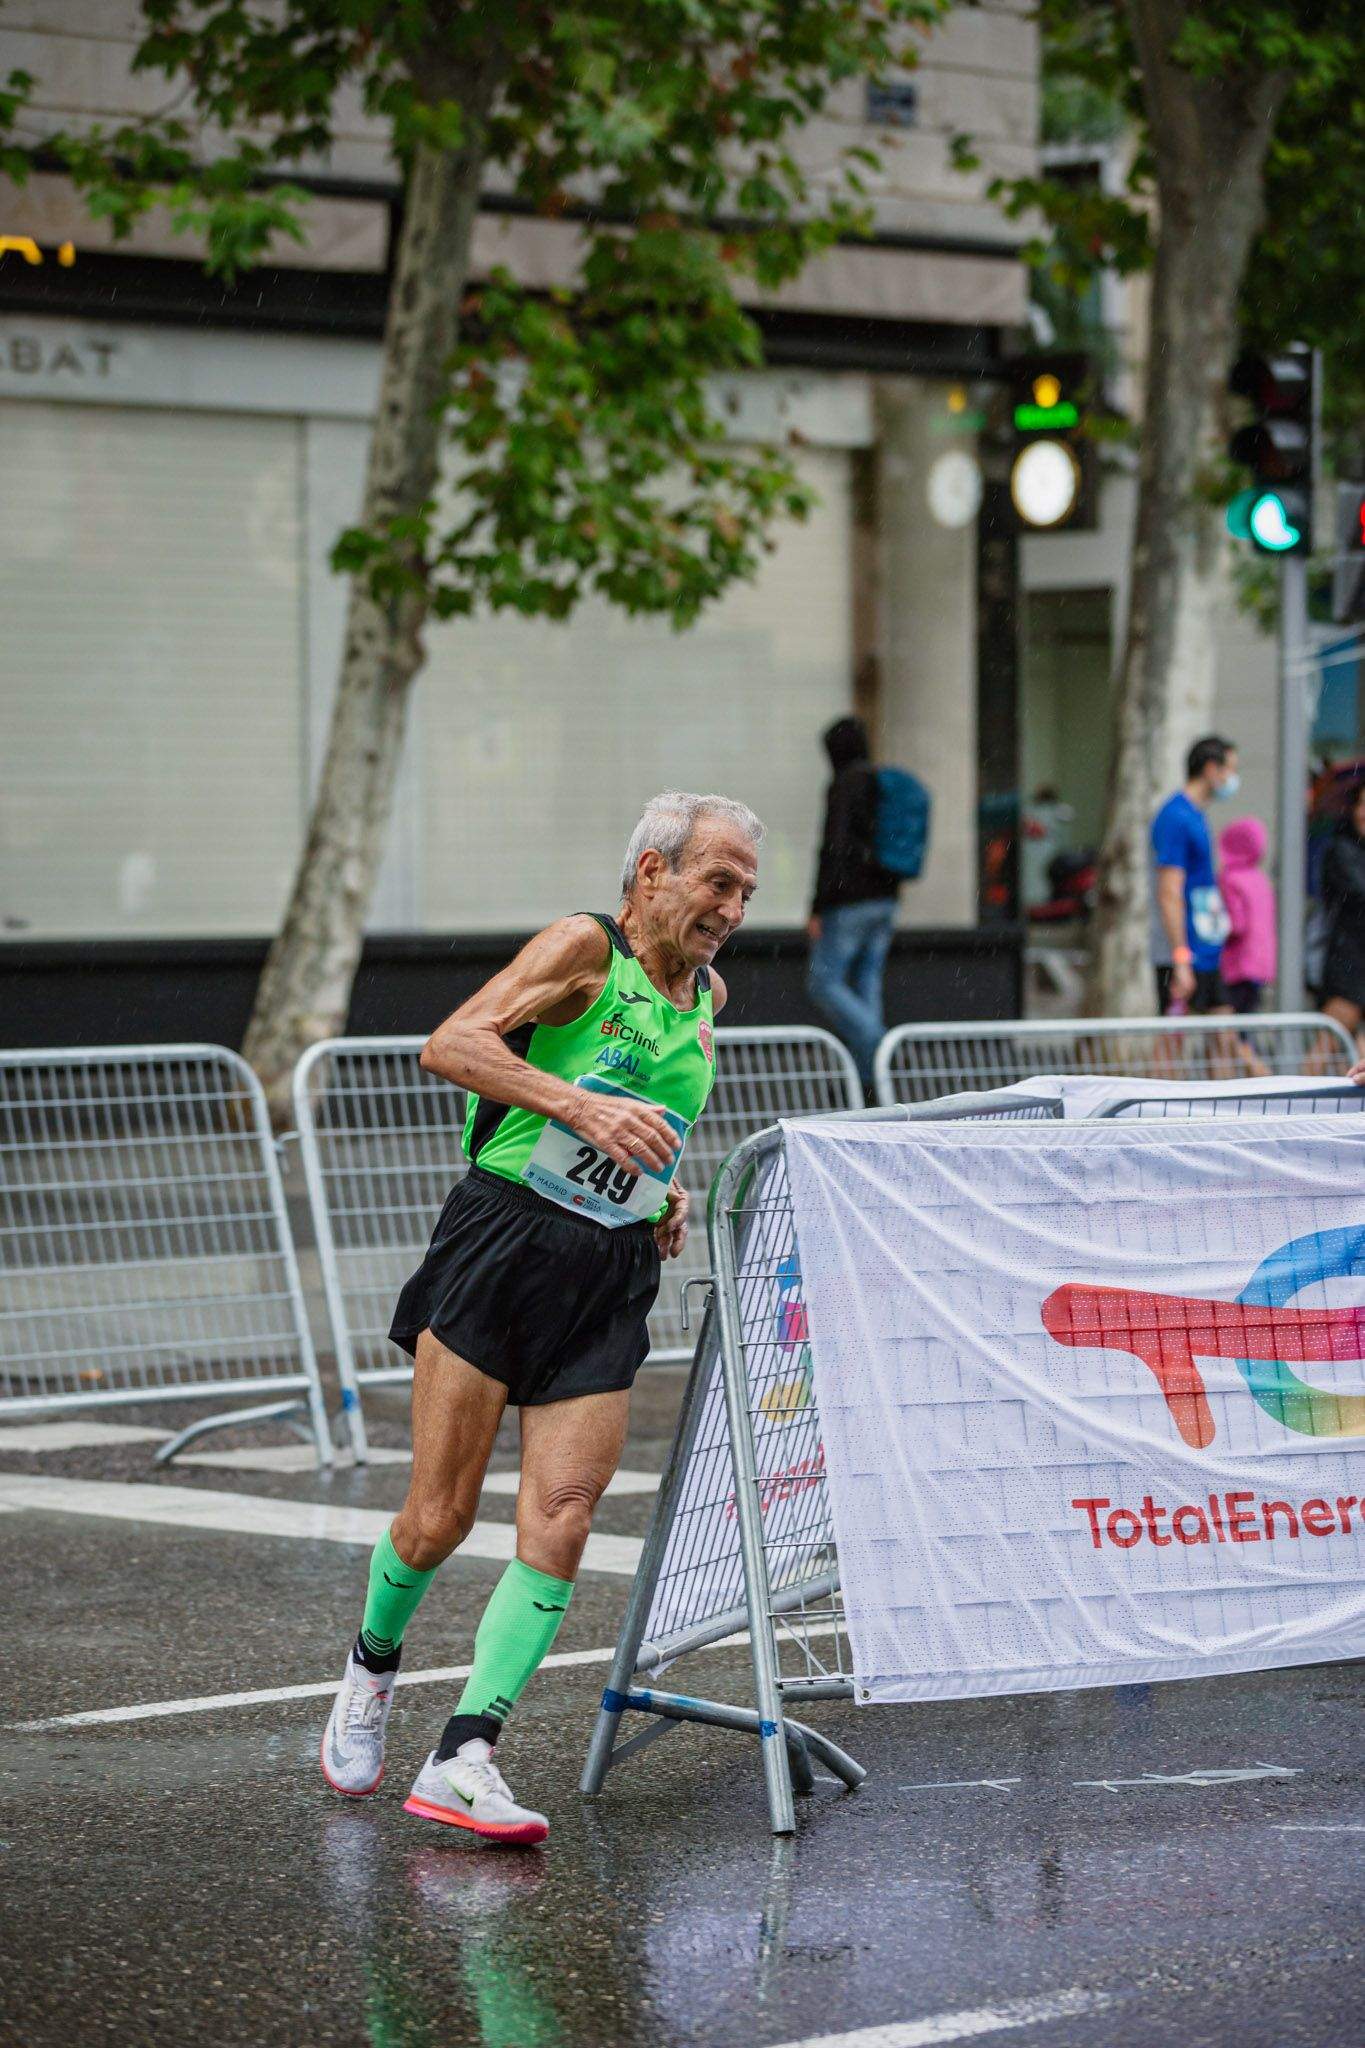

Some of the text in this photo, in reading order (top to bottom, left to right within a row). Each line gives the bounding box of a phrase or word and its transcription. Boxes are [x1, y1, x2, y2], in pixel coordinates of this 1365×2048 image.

[0, 335, 118, 378] BAT
[601, 1020, 660, 1057] BiClinic
[536, 1176, 568, 1196] MADRID
[565, 1145, 639, 1205] 249
[1072, 1491, 1365, 1549] TotalEner
